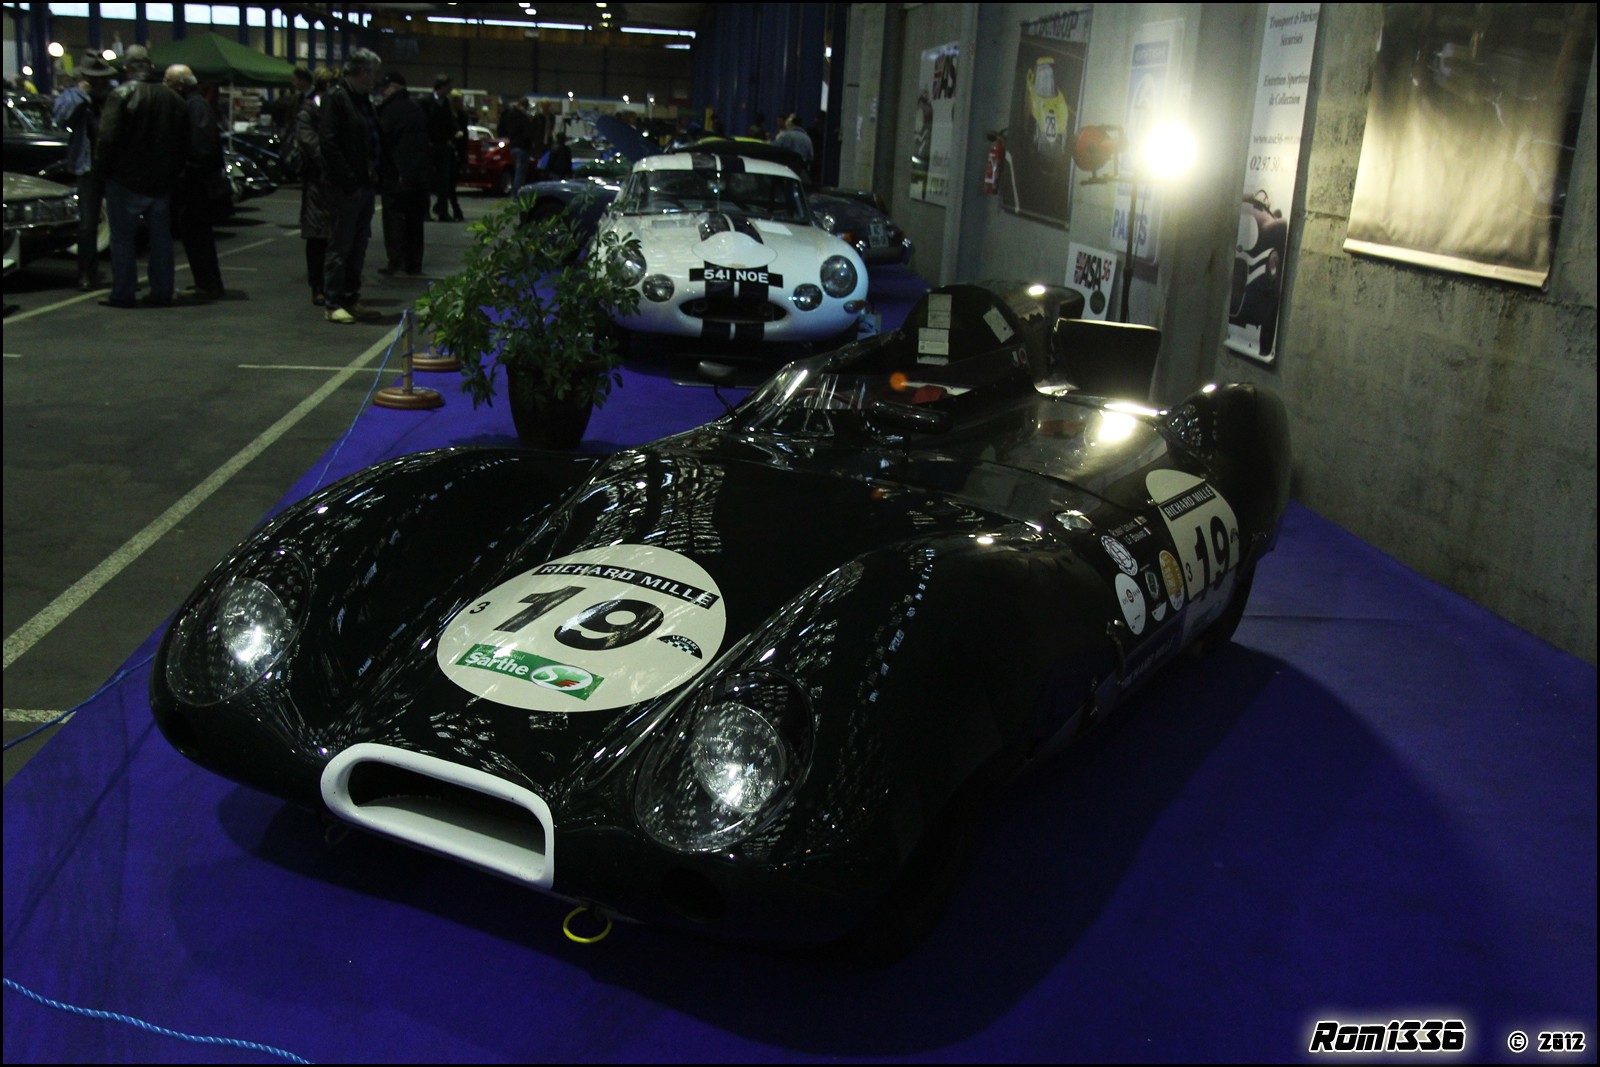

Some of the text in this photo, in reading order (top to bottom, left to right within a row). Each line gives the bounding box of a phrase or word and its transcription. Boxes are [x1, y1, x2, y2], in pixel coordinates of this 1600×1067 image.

[1275, 92, 1301, 105] Collection
[1112, 208, 1148, 246] PATS
[736, 270, 769, 284] NOE
[1163, 486, 1213, 518] RICHARD MILLE
[1195, 516, 1230, 600] 19
[1186, 562, 1193, 582] 3
[541, 564, 713, 607] RICHARD MILLE
[469, 601, 491, 614] 3
[493, 585, 664, 651] 19
[680, 637, 699, 650] MANS
[465, 652, 529, 675] Sarthe
